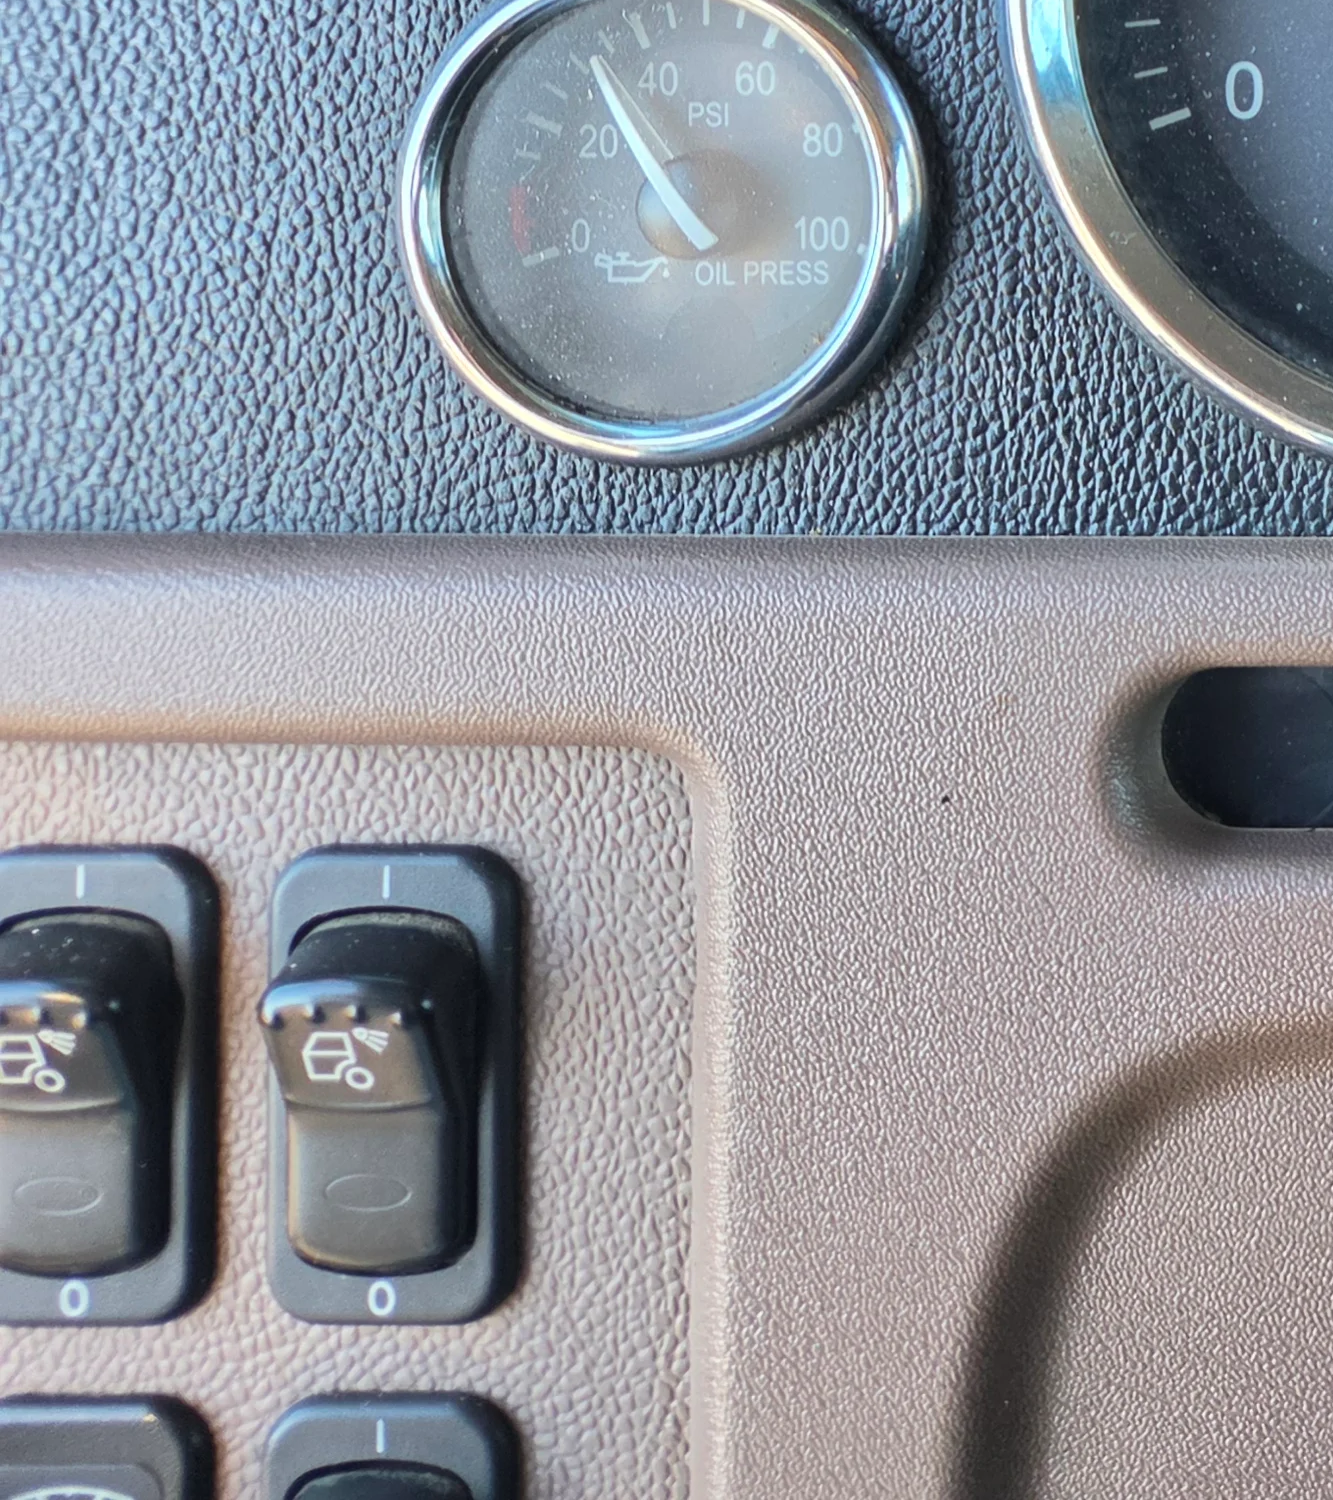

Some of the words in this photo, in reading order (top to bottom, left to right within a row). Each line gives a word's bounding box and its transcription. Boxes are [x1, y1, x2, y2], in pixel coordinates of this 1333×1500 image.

[638, 61, 679, 96] 40
[735, 61, 776, 97] 60
[1224, 60, 1264, 119] 0
[688, 102, 729, 127] PSI
[579, 124, 618, 159] 20
[803, 123, 843, 158] 80
[571, 218, 591, 254] 0
[794, 216, 850, 252] 100
[695, 261, 735, 286] OIL
[744, 261, 829, 285] PRESS
